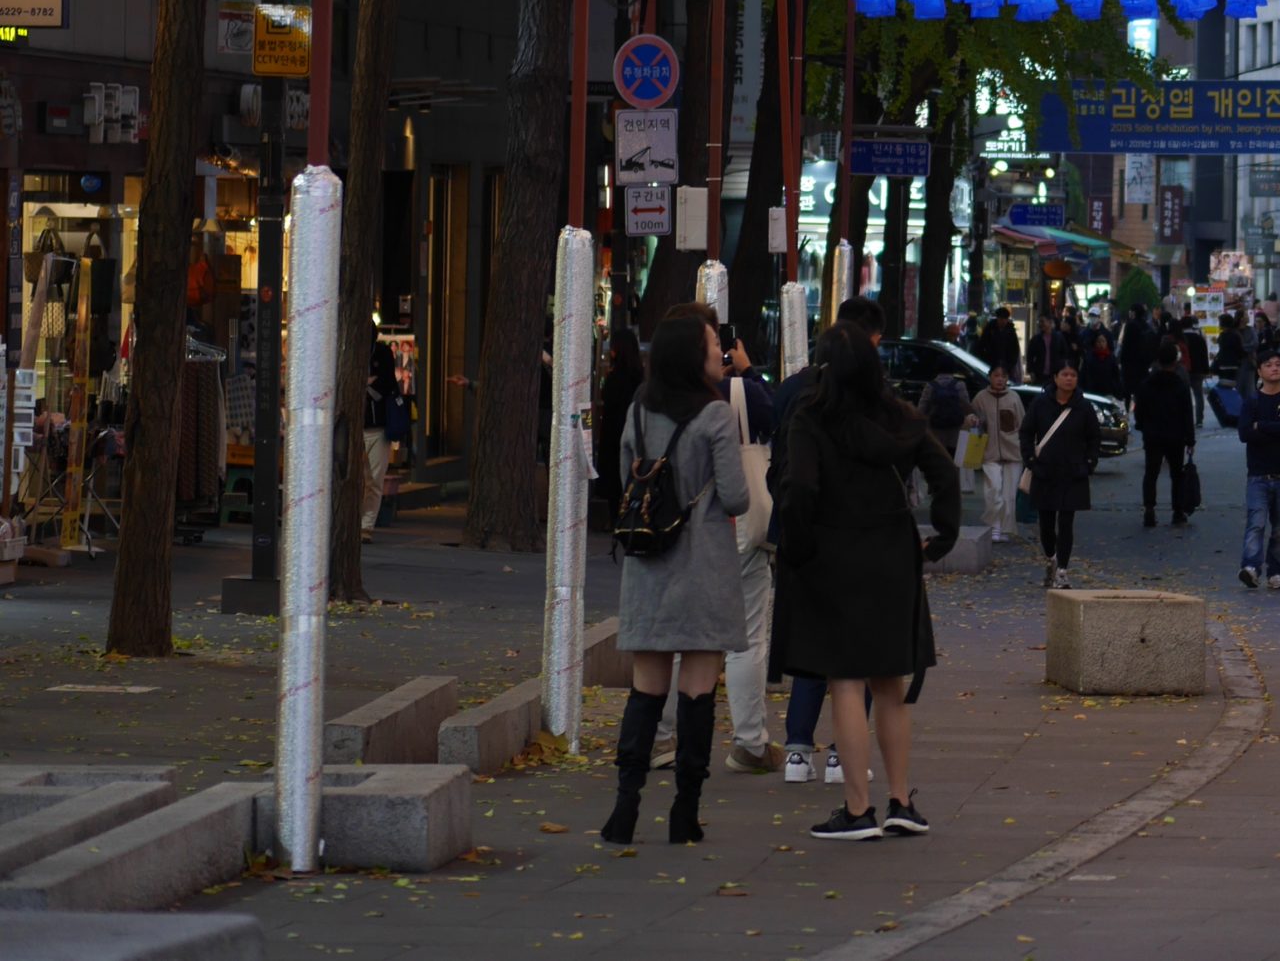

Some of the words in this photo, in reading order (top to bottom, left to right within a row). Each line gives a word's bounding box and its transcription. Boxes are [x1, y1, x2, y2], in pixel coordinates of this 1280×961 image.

[258, 39, 306, 51] 불법주정차
[623, 66, 670, 79] 주정차금지
[624, 118, 671, 132] 견인지역
[1155, 123, 1200, 133] Exhibition
[631, 190, 665, 203] 구간내
[633, 220, 664, 231] 100m
